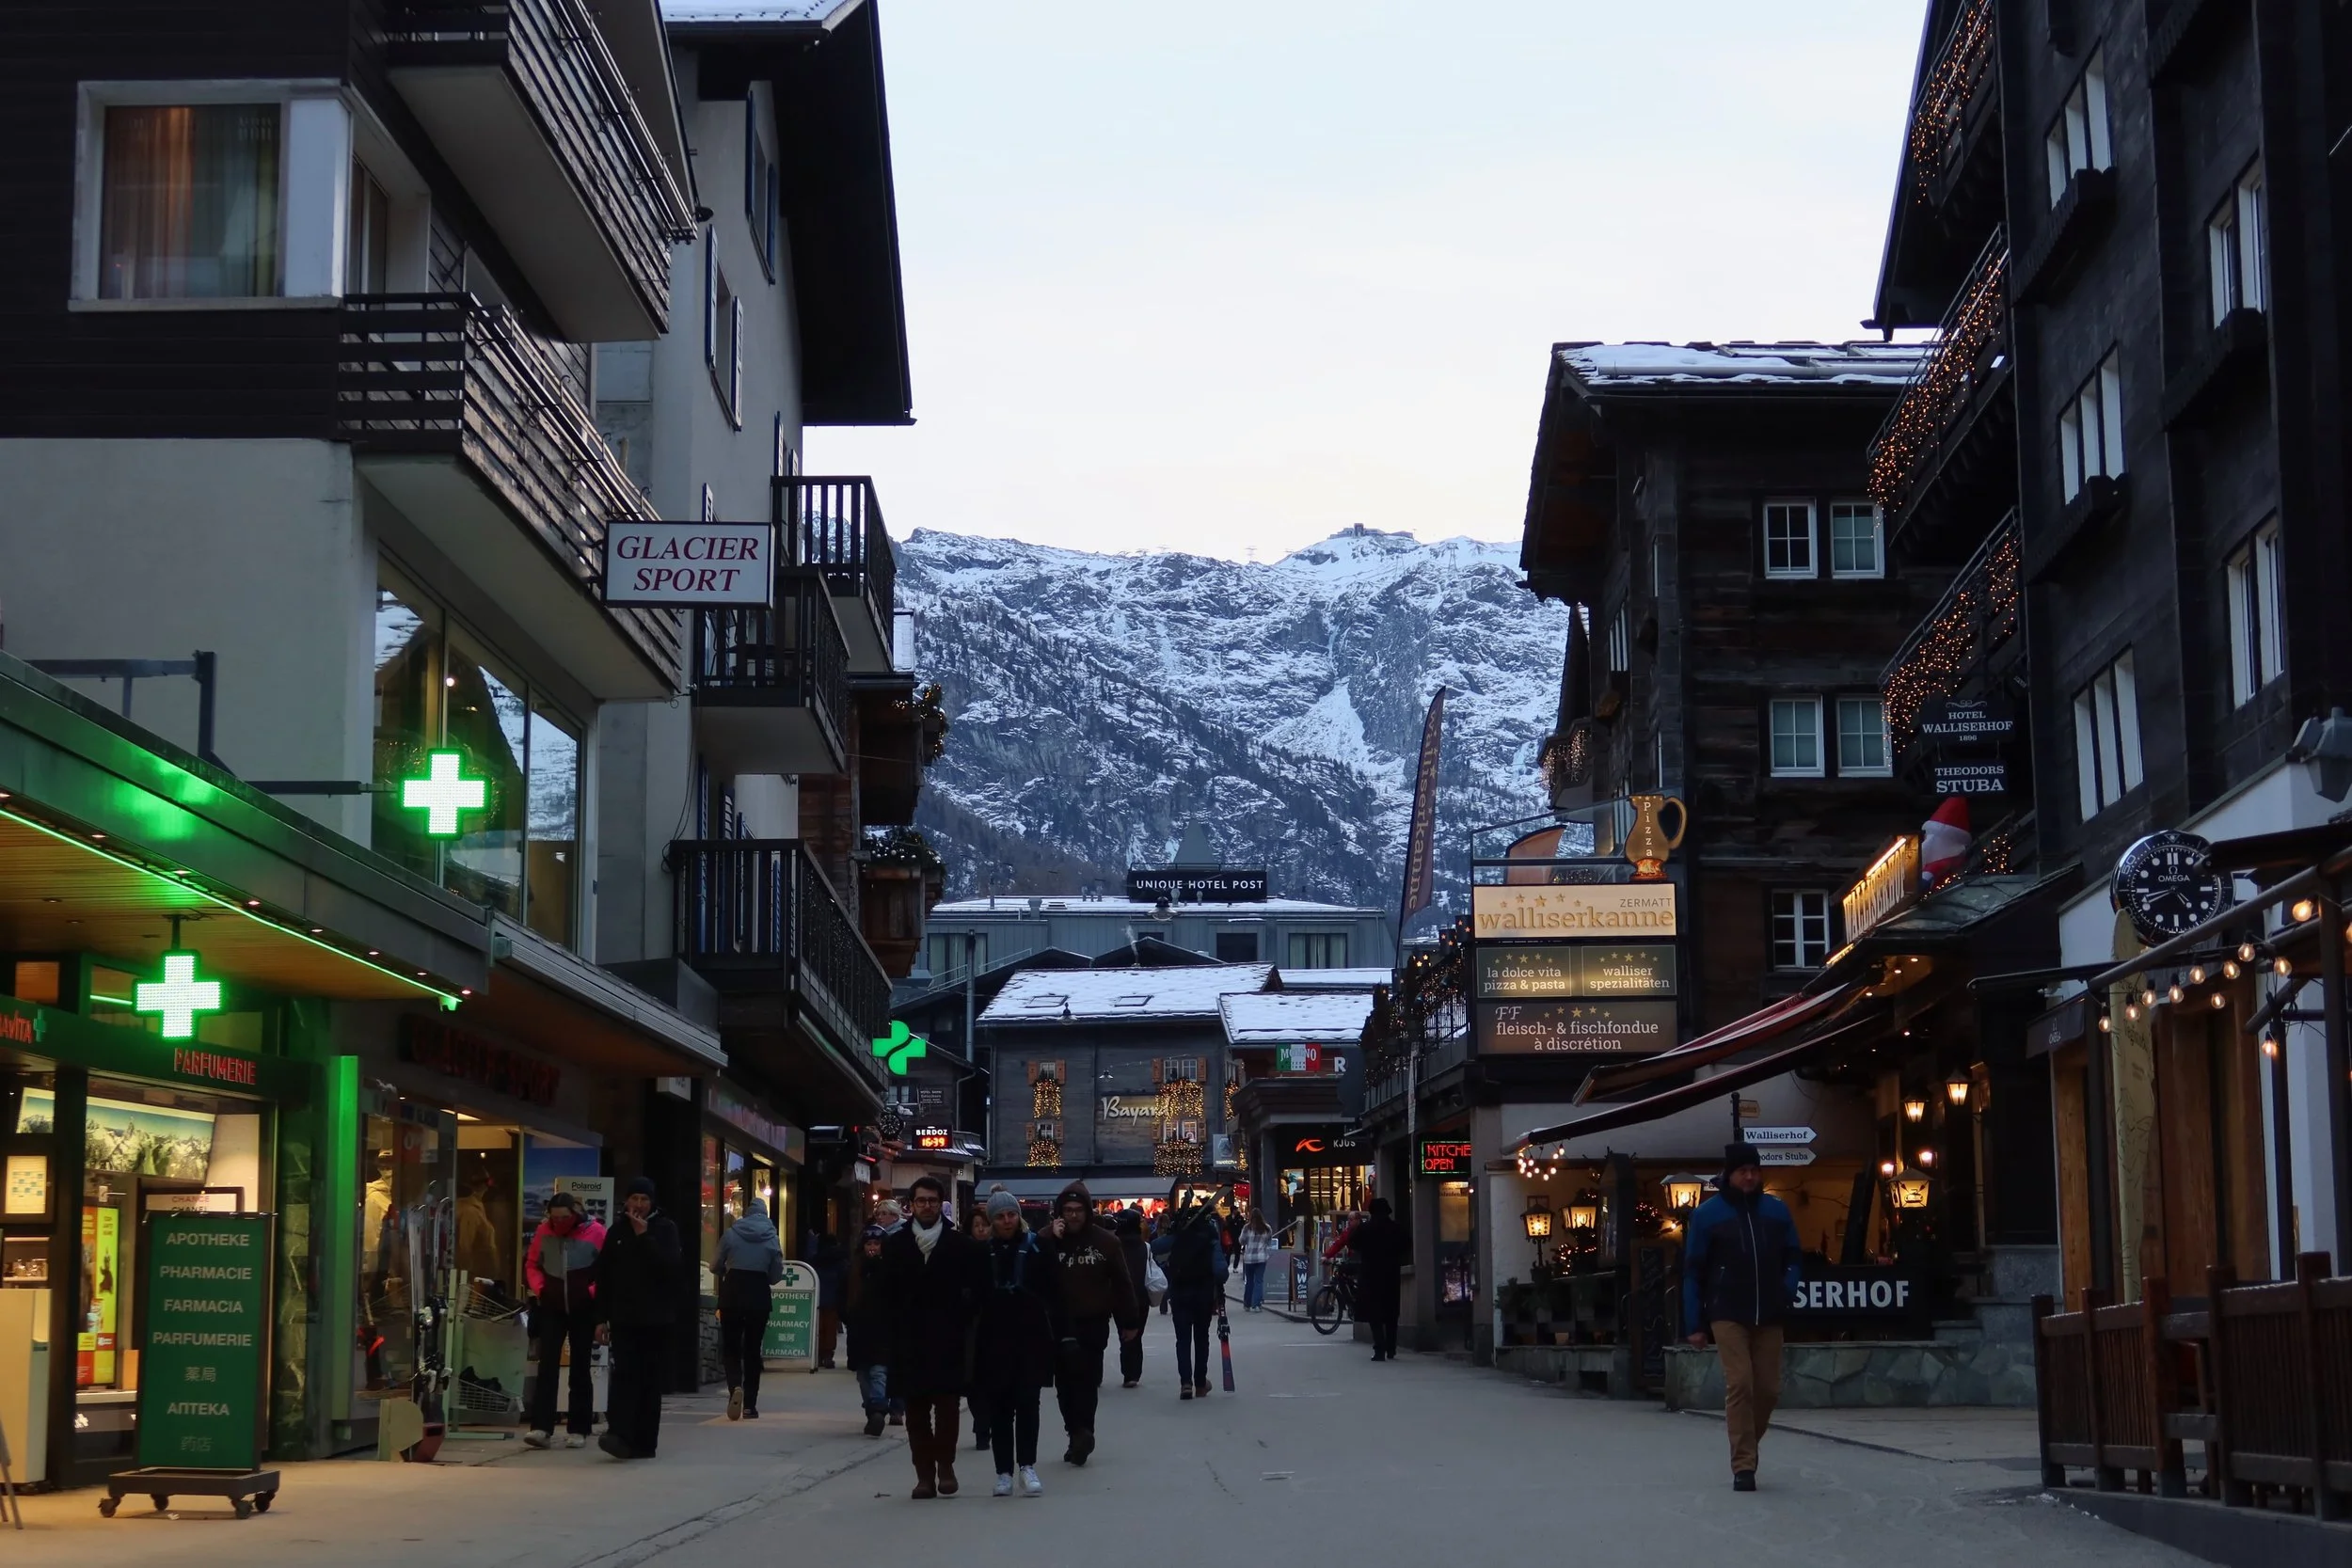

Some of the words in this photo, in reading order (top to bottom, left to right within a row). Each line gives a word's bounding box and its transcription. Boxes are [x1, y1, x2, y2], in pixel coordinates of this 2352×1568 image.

[617, 535, 758, 560] GLACIER
[633, 567, 740, 592] SPORT
[1947, 711, 1986, 720] HOTEL
[1922, 721, 2013, 734] WALLISERHOF
[1934, 766, 2004, 776] THEODORS
[1936, 778, 2005, 793] STUBA
[1644, 802, 1652, 856] Pizza
[1136, 880, 1183, 889] UNIQUE
[1188, 880, 1228, 889] HOTEL
[1232, 880, 1263, 889] POST
[1620, 898, 1672, 908] ZERMATT
[1478, 906, 1674, 929] walliserkanne
[1487, 967, 1500, 977] la
[1502, 967, 1534, 977] dolce
[1538, 967, 1562, 977] vita
[1603, 965, 1653, 976] walliser
[1484, 979, 1517, 992] pizza
[1520, 980, 1529, 990] &
[1532, 979, 1565, 991] pasta
[1590, 978, 1670, 991] spezialitäten
[1496, 1022, 1551, 1035] fleisch-
[1556, 1022, 1566, 1035] &
[1570, 1021, 1659, 1034] fischfondue
[1534, 1038, 1542, 1051] à
[1547, 1037, 1622, 1050] discrétion
[173, 1047, 257, 1085] PARFUMERIE
[922, 1137, 945, 1147] 16:39
[1333, 1139, 1356, 1148] KJUS
[1425, 1145, 1471, 1156] KITCHE
[1424, 1158, 1454, 1171] OPEN
[572, 1181, 602, 1190] Polaroid
[166, 1233, 250, 1246] APOTHEKE
[160, 1266, 252, 1279] PHARMACIE
[164, 1299, 244, 1313] FARMACIA
[152, 1332, 252, 1347] PARFUMERIE
